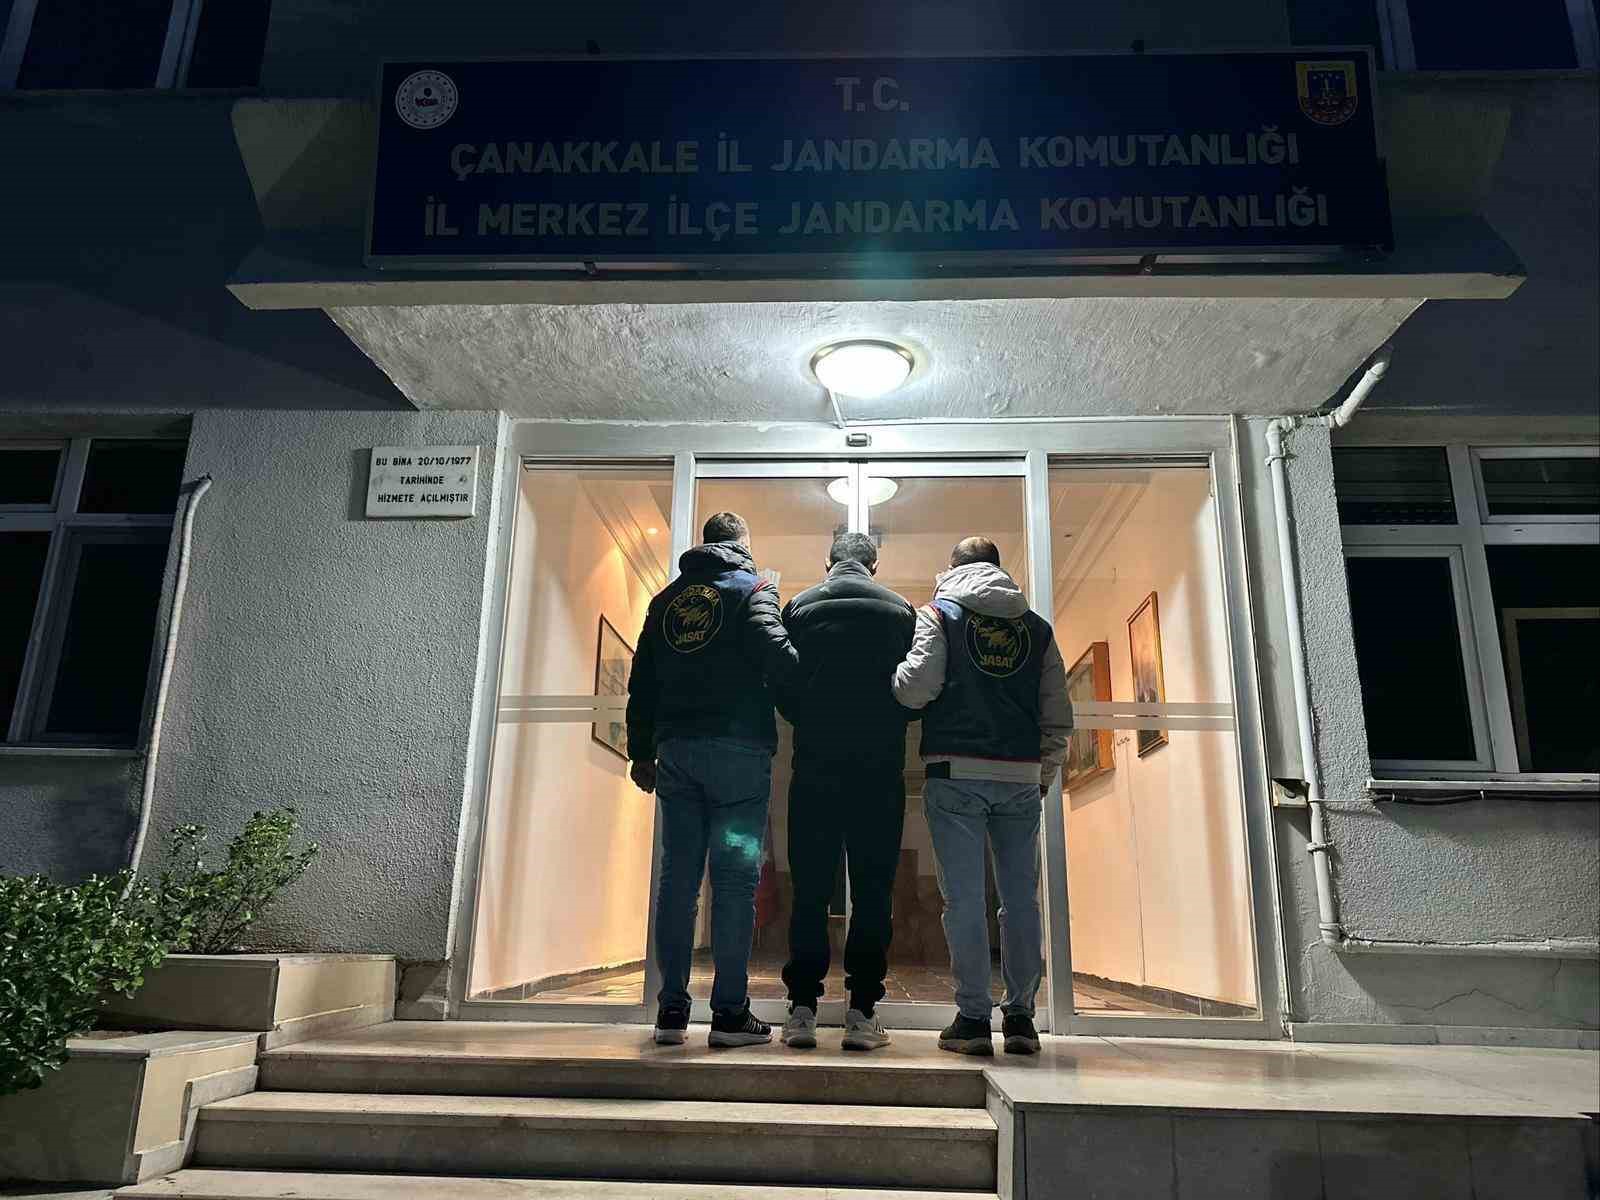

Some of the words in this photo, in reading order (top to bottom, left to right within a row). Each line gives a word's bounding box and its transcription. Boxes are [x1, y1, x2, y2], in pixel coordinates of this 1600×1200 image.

[834, 76, 911, 112] T.C.
[450, 139, 699, 181] ÇANAKKALE
[717, 131, 752, 173] İL
[770, 137, 1000, 172] JANDARMA
[1019, 124, 1299, 168] KOMUTANLIĞI
[423, 195, 459, 237] İL
[477, 201, 649, 236] MERKEZ
[667, 193, 759, 241] İLÇE
[778, 199, 1020, 234] JANDARMA
[1040, 186, 1328, 231] KOMUTANLIĞI
[376, 457, 387, 466] BU
[393, 456, 412, 466] BİNA
[418, 457, 471, 466] 20/10/1977
[400, 474, 445, 485] TARİHİNDE
[377, 493, 415, 503] HİZMETE
[675, 630, 706, 646] JASAT
[979, 654, 1015, 669] JASAT
